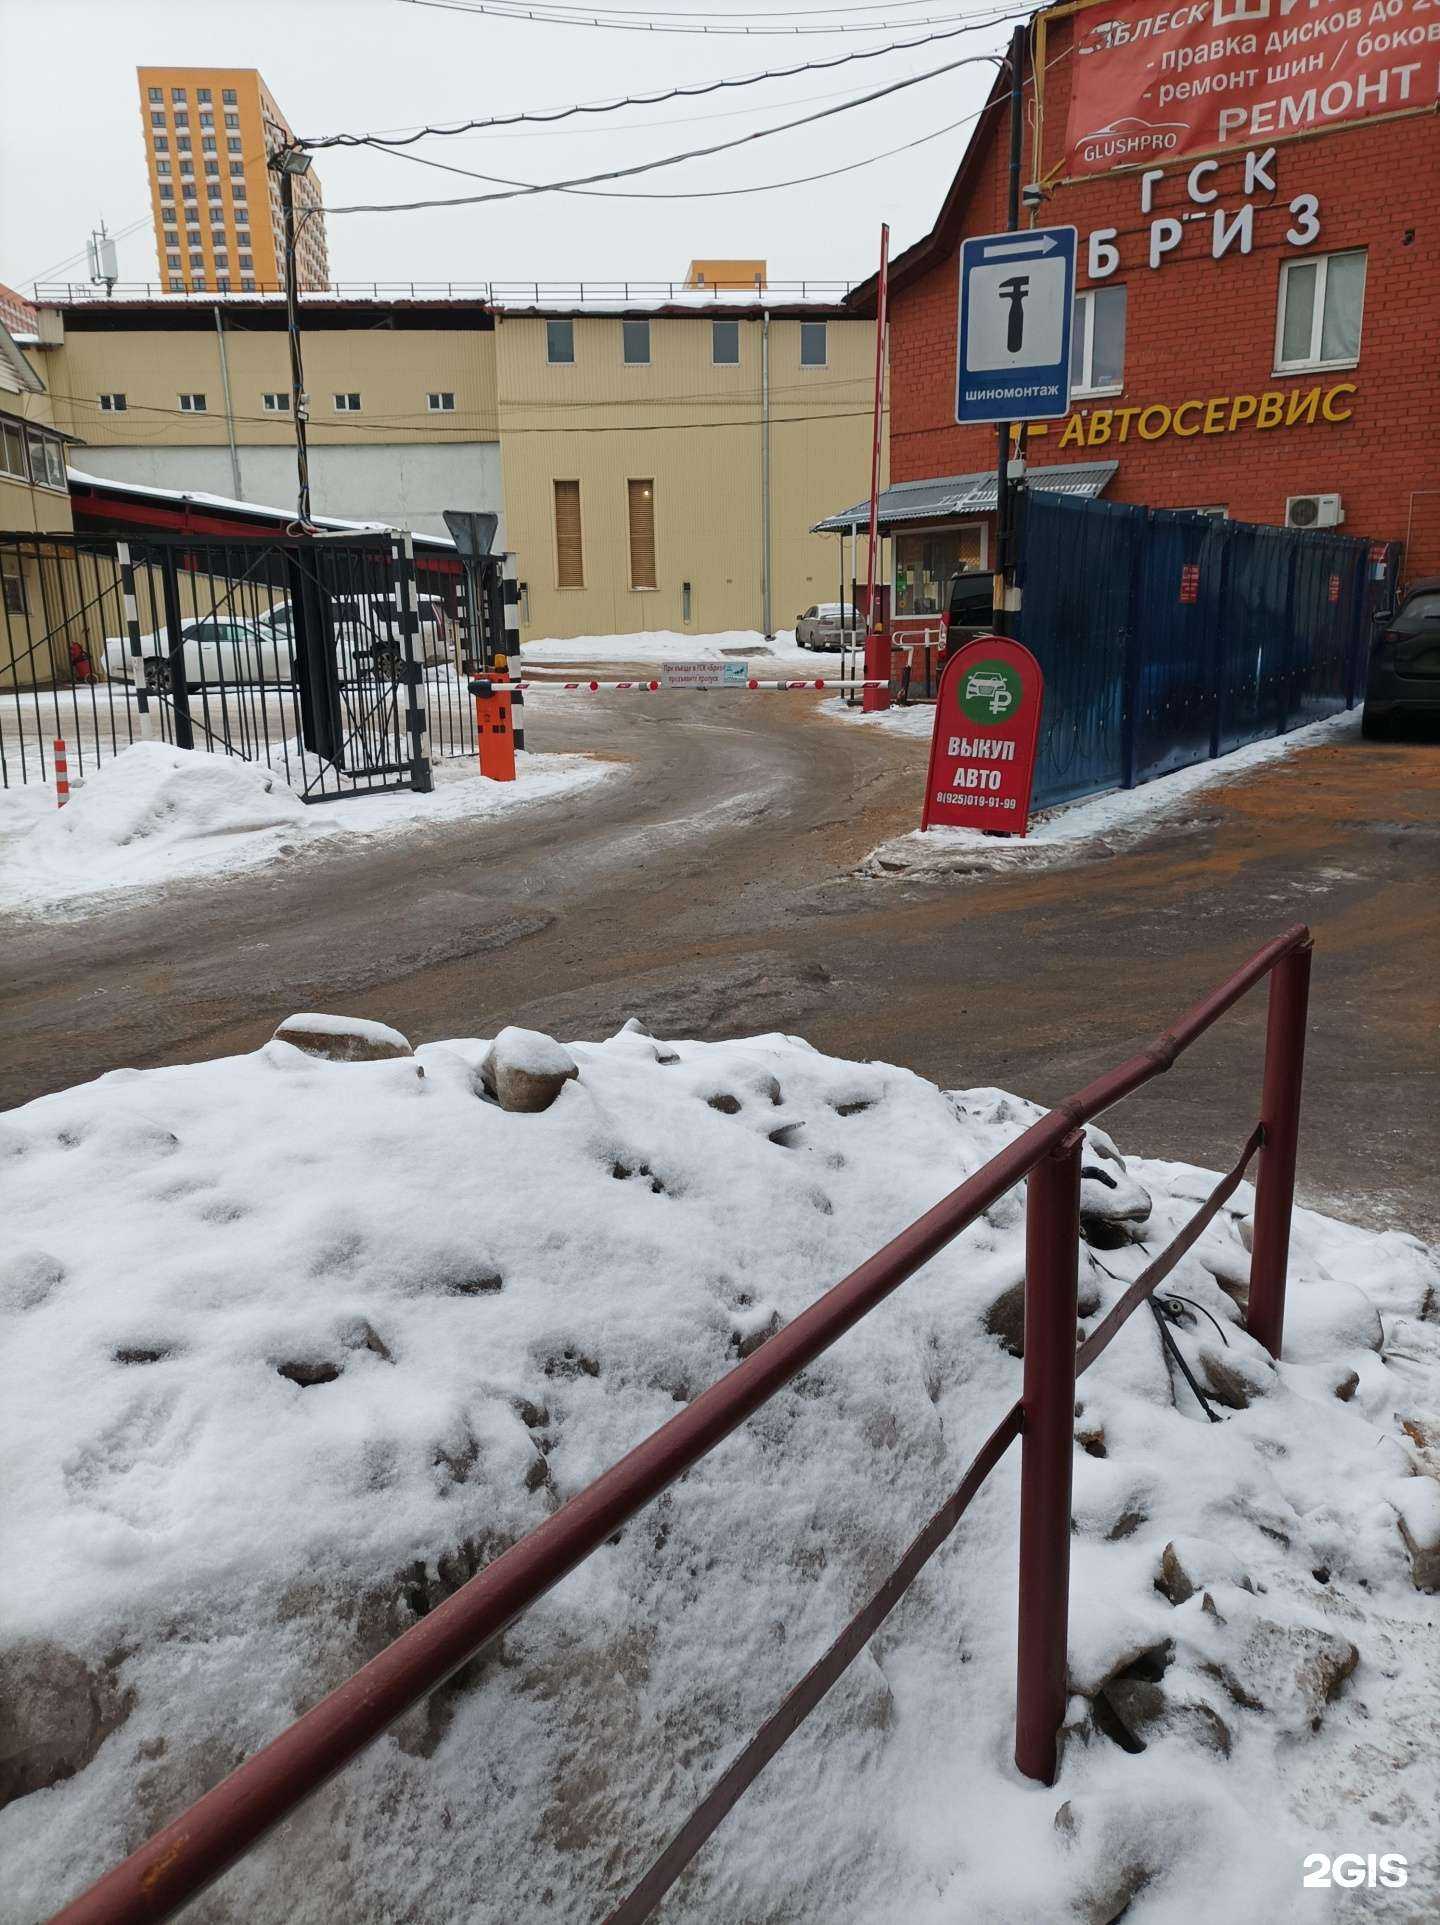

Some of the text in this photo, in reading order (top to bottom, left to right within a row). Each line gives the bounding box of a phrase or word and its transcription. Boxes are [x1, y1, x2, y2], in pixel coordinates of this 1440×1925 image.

[1161, 33, 1257, 73] правка
[1264, 8, 1362, 56] дисков
[1368, 0, 1403, 26] до
[1158, 68, 1259, 107] ремонт
[1266, 52, 1325, 85] шин
[1217, 62, 1422, 143] РЕМОНТ
[1083, 133, 1178, 163] GLUSHPRO
[1140, 147, 1277, 215] ГСК
[1087, 193, 1321, 280] БРИЗ
[965, 384, 1060, 401] шиномонтаж
[1058, 384, 1357, 448] АВТОСЕРВИС
[948, 737, 1015, 760] ВЫКУП
[953, 768, 1001, 790] АВТО
